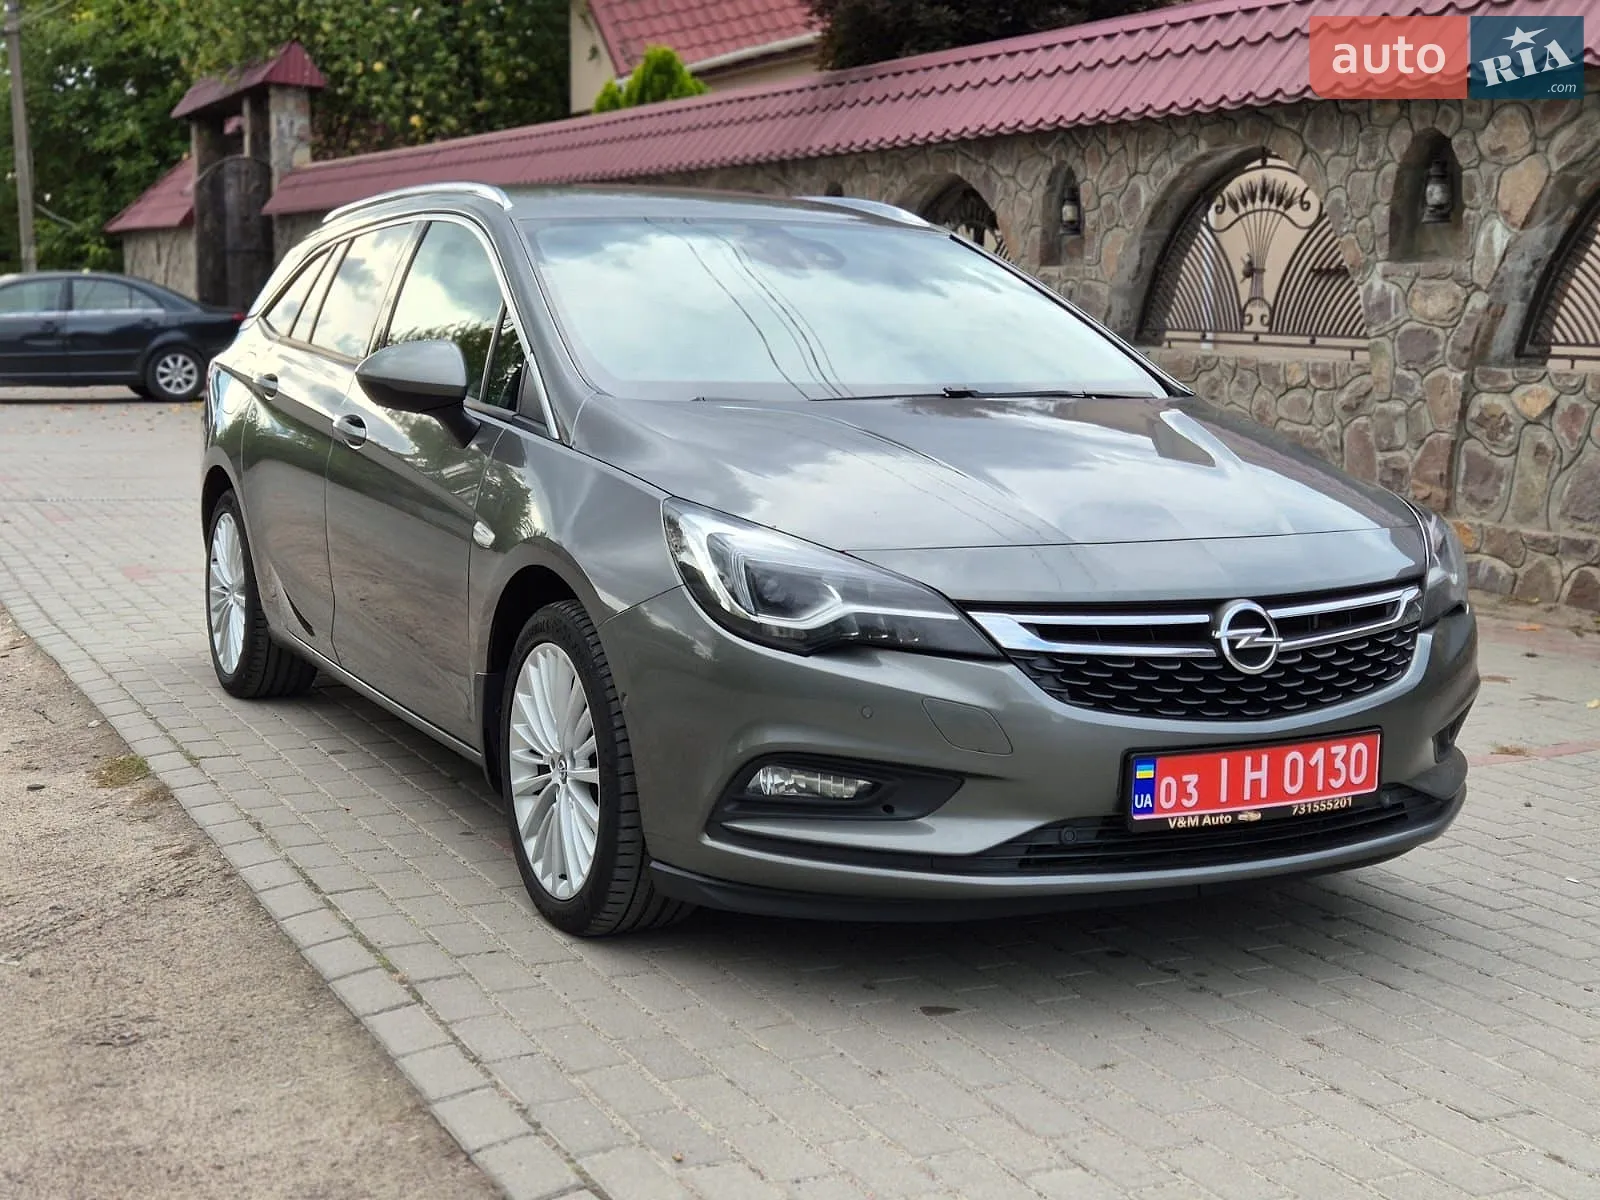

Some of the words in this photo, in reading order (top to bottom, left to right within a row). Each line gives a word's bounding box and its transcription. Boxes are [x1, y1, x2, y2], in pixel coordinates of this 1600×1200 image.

[1159, 774, 1199, 809] 03
[1220, 754, 1268, 802] IH
[1283, 742, 1368, 795] 0130
[1134, 793, 1153, 809] UA
[1168, 815, 1200, 829] V&M
[1202, 813, 1232, 826] Auto
[1291, 796, 1352, 816] 731555201
